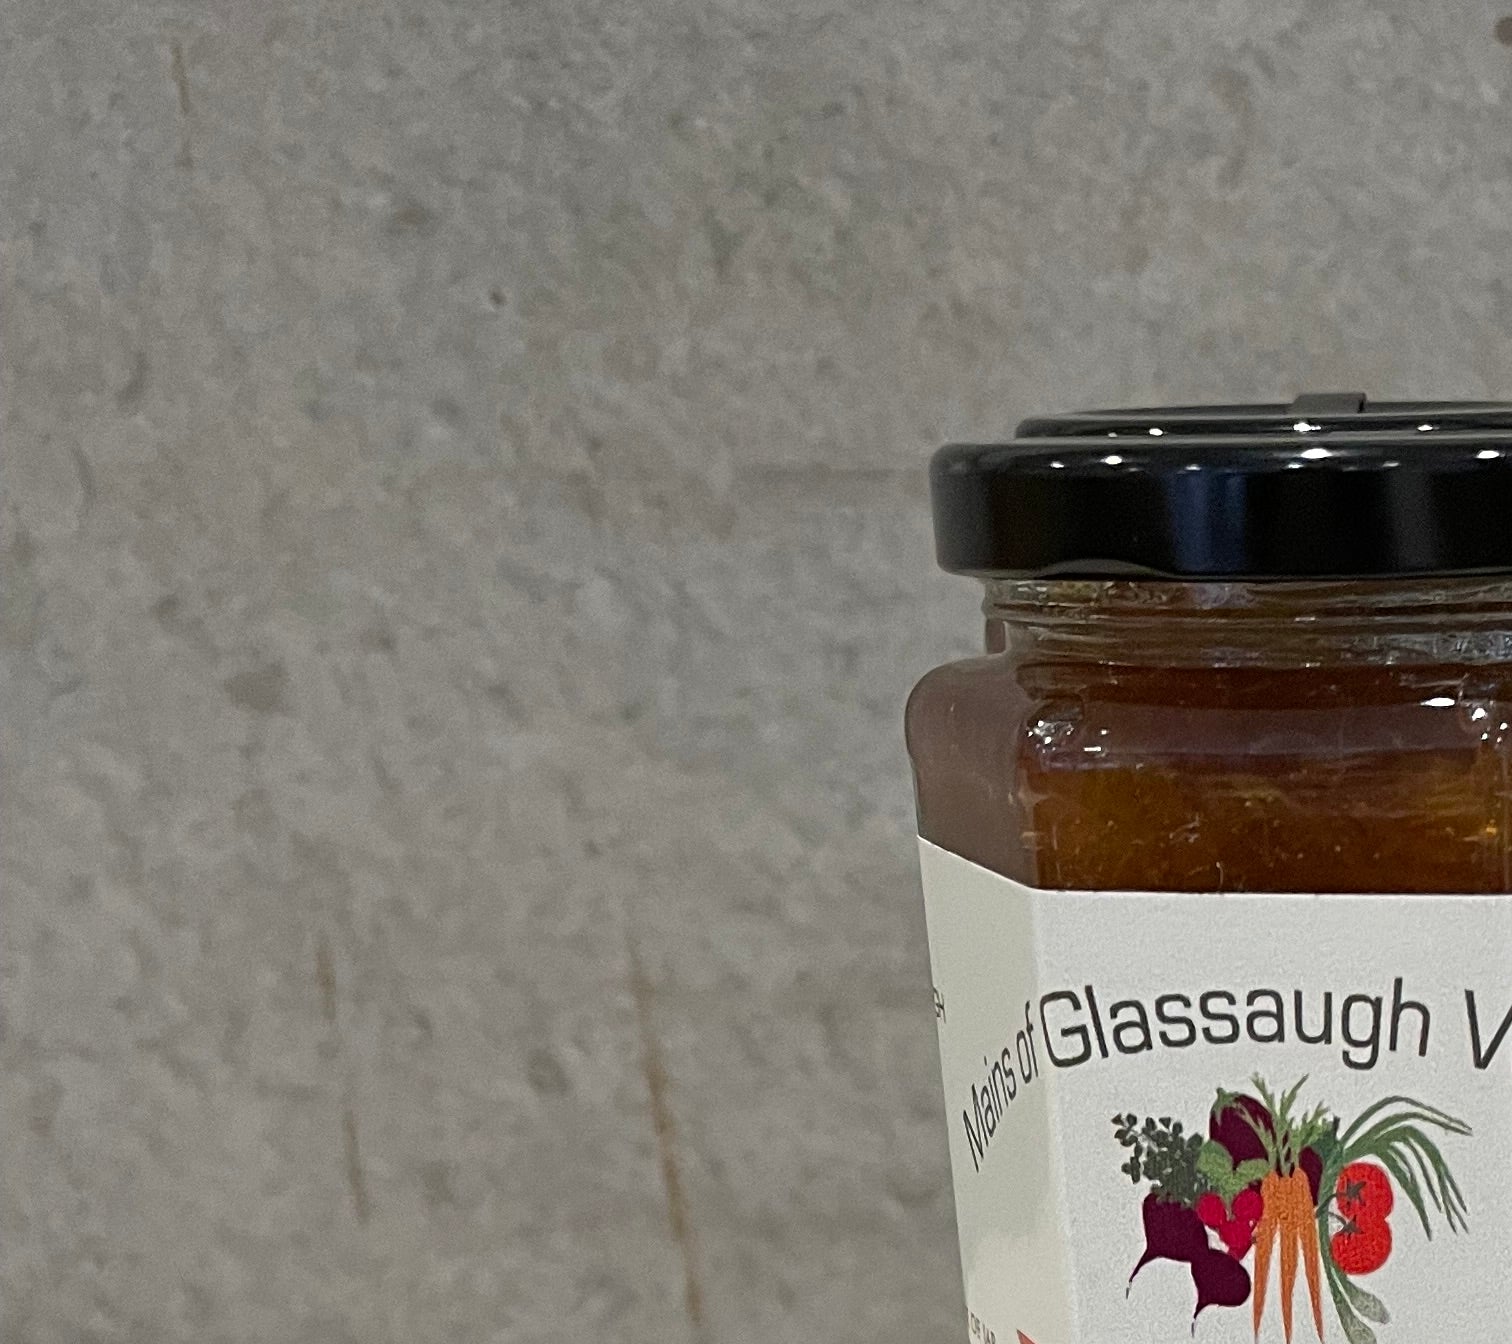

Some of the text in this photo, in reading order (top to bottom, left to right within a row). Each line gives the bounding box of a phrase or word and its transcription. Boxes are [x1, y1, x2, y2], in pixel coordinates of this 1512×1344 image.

[961, 1040, 1017, 1173] Mains
[1015, 1000, 1038, 1085] of
[1039, 978, 1431, 1069] Glassaugh
